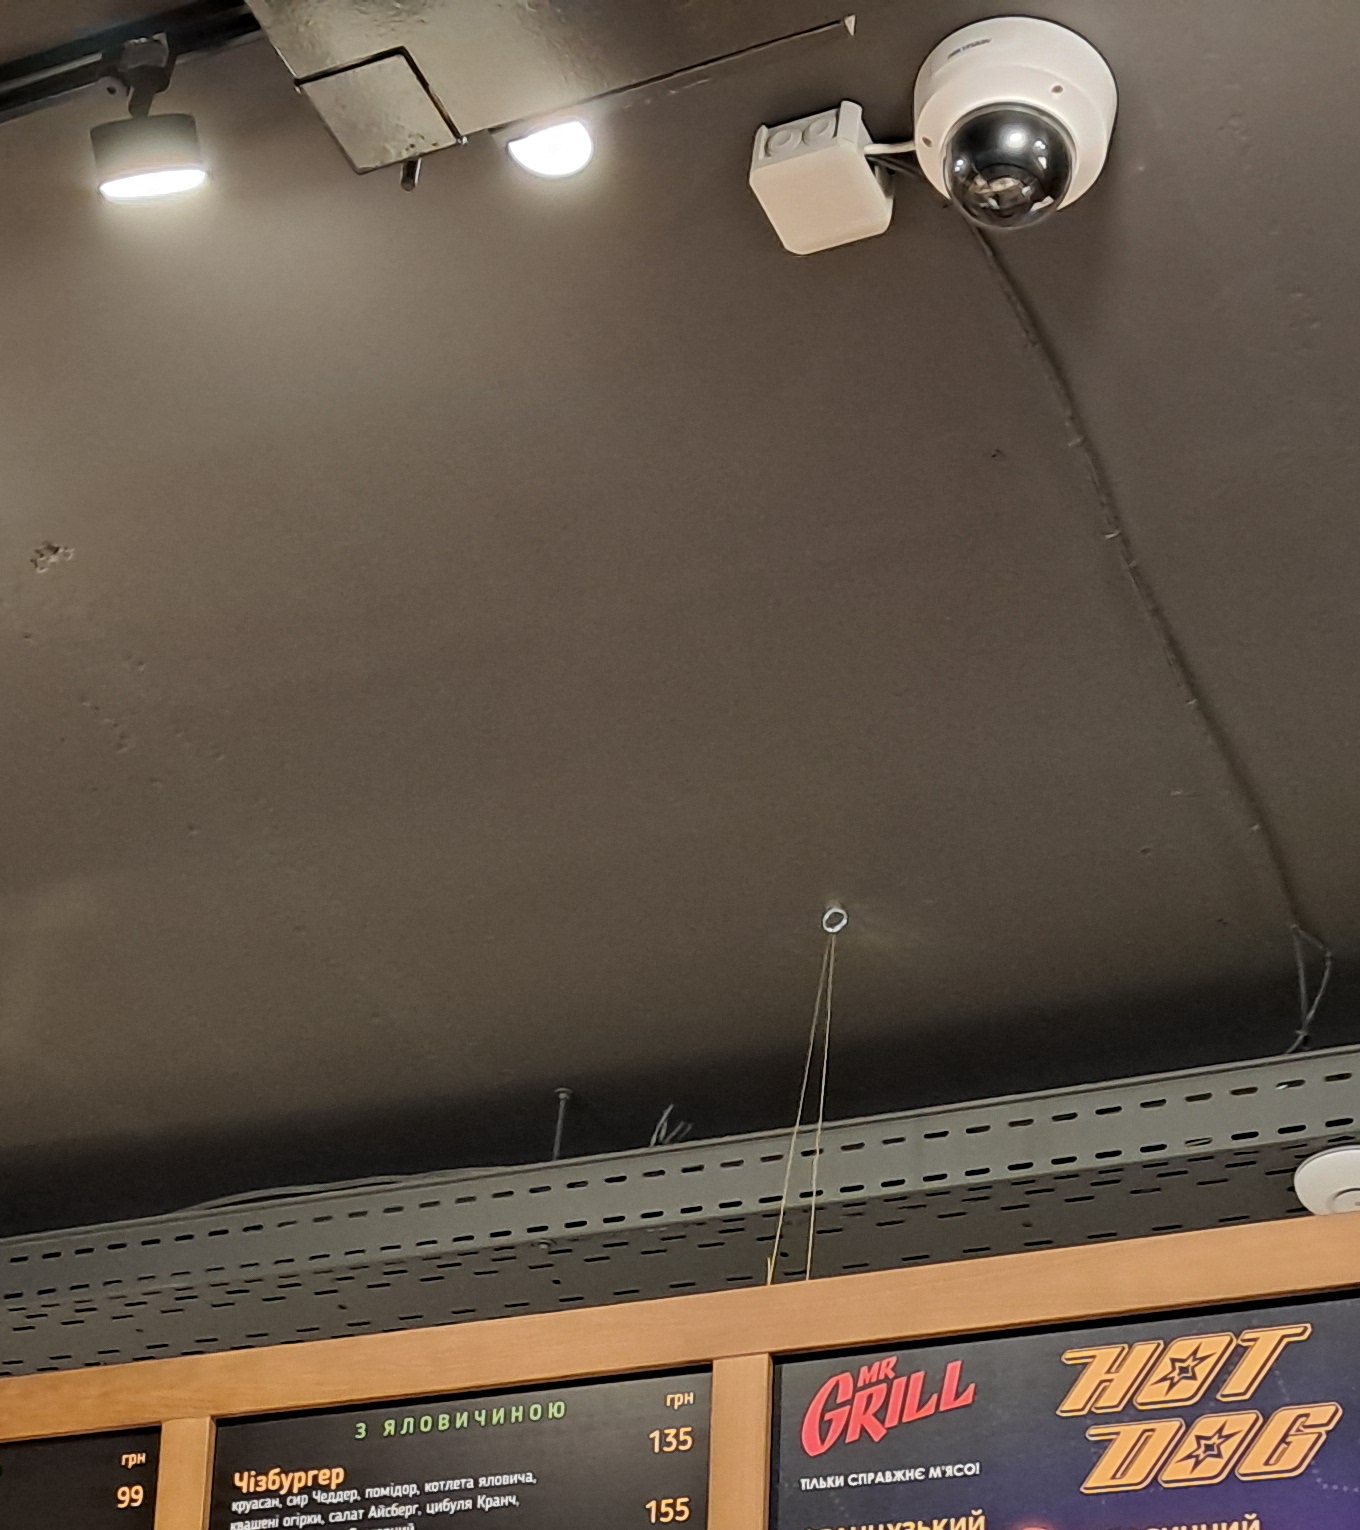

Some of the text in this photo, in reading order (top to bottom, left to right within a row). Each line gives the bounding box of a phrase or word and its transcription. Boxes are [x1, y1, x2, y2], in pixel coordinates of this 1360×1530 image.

[857, 1356, 899, 1389] MR
[1056, 1323, 1312, 1416] HOT
[666, 1391, 694, 1410] грн
[801, 1360, 976, 1457] GRILL
[383, 1401, 565, 1437] ЯЛОВИЧИНОЮ
[649, 1426, 693, 1453] 135
[1080, 1402, 1343, 1494] DOG
[121, 1452, 147, 1469] грн
[233, 1467, 345, 1495] Чізбургер
[800, 1475, 845, 1491] ТІЛЬКИ
[847, 1468, 926, 1488] СПРАВЖНЄ
[117, 1485, 144, 1509] 99
[645, 1497, 690, 1524] 155
[282, 1512, 326, 1529] огірки,
[328, 1509, 365, 1523] салат
[367, 1502, 422, 1519] Айсберг,
[425, 1497, 473, 1515] цибуля
[476, 1494, 520, 1512] Кранч,
